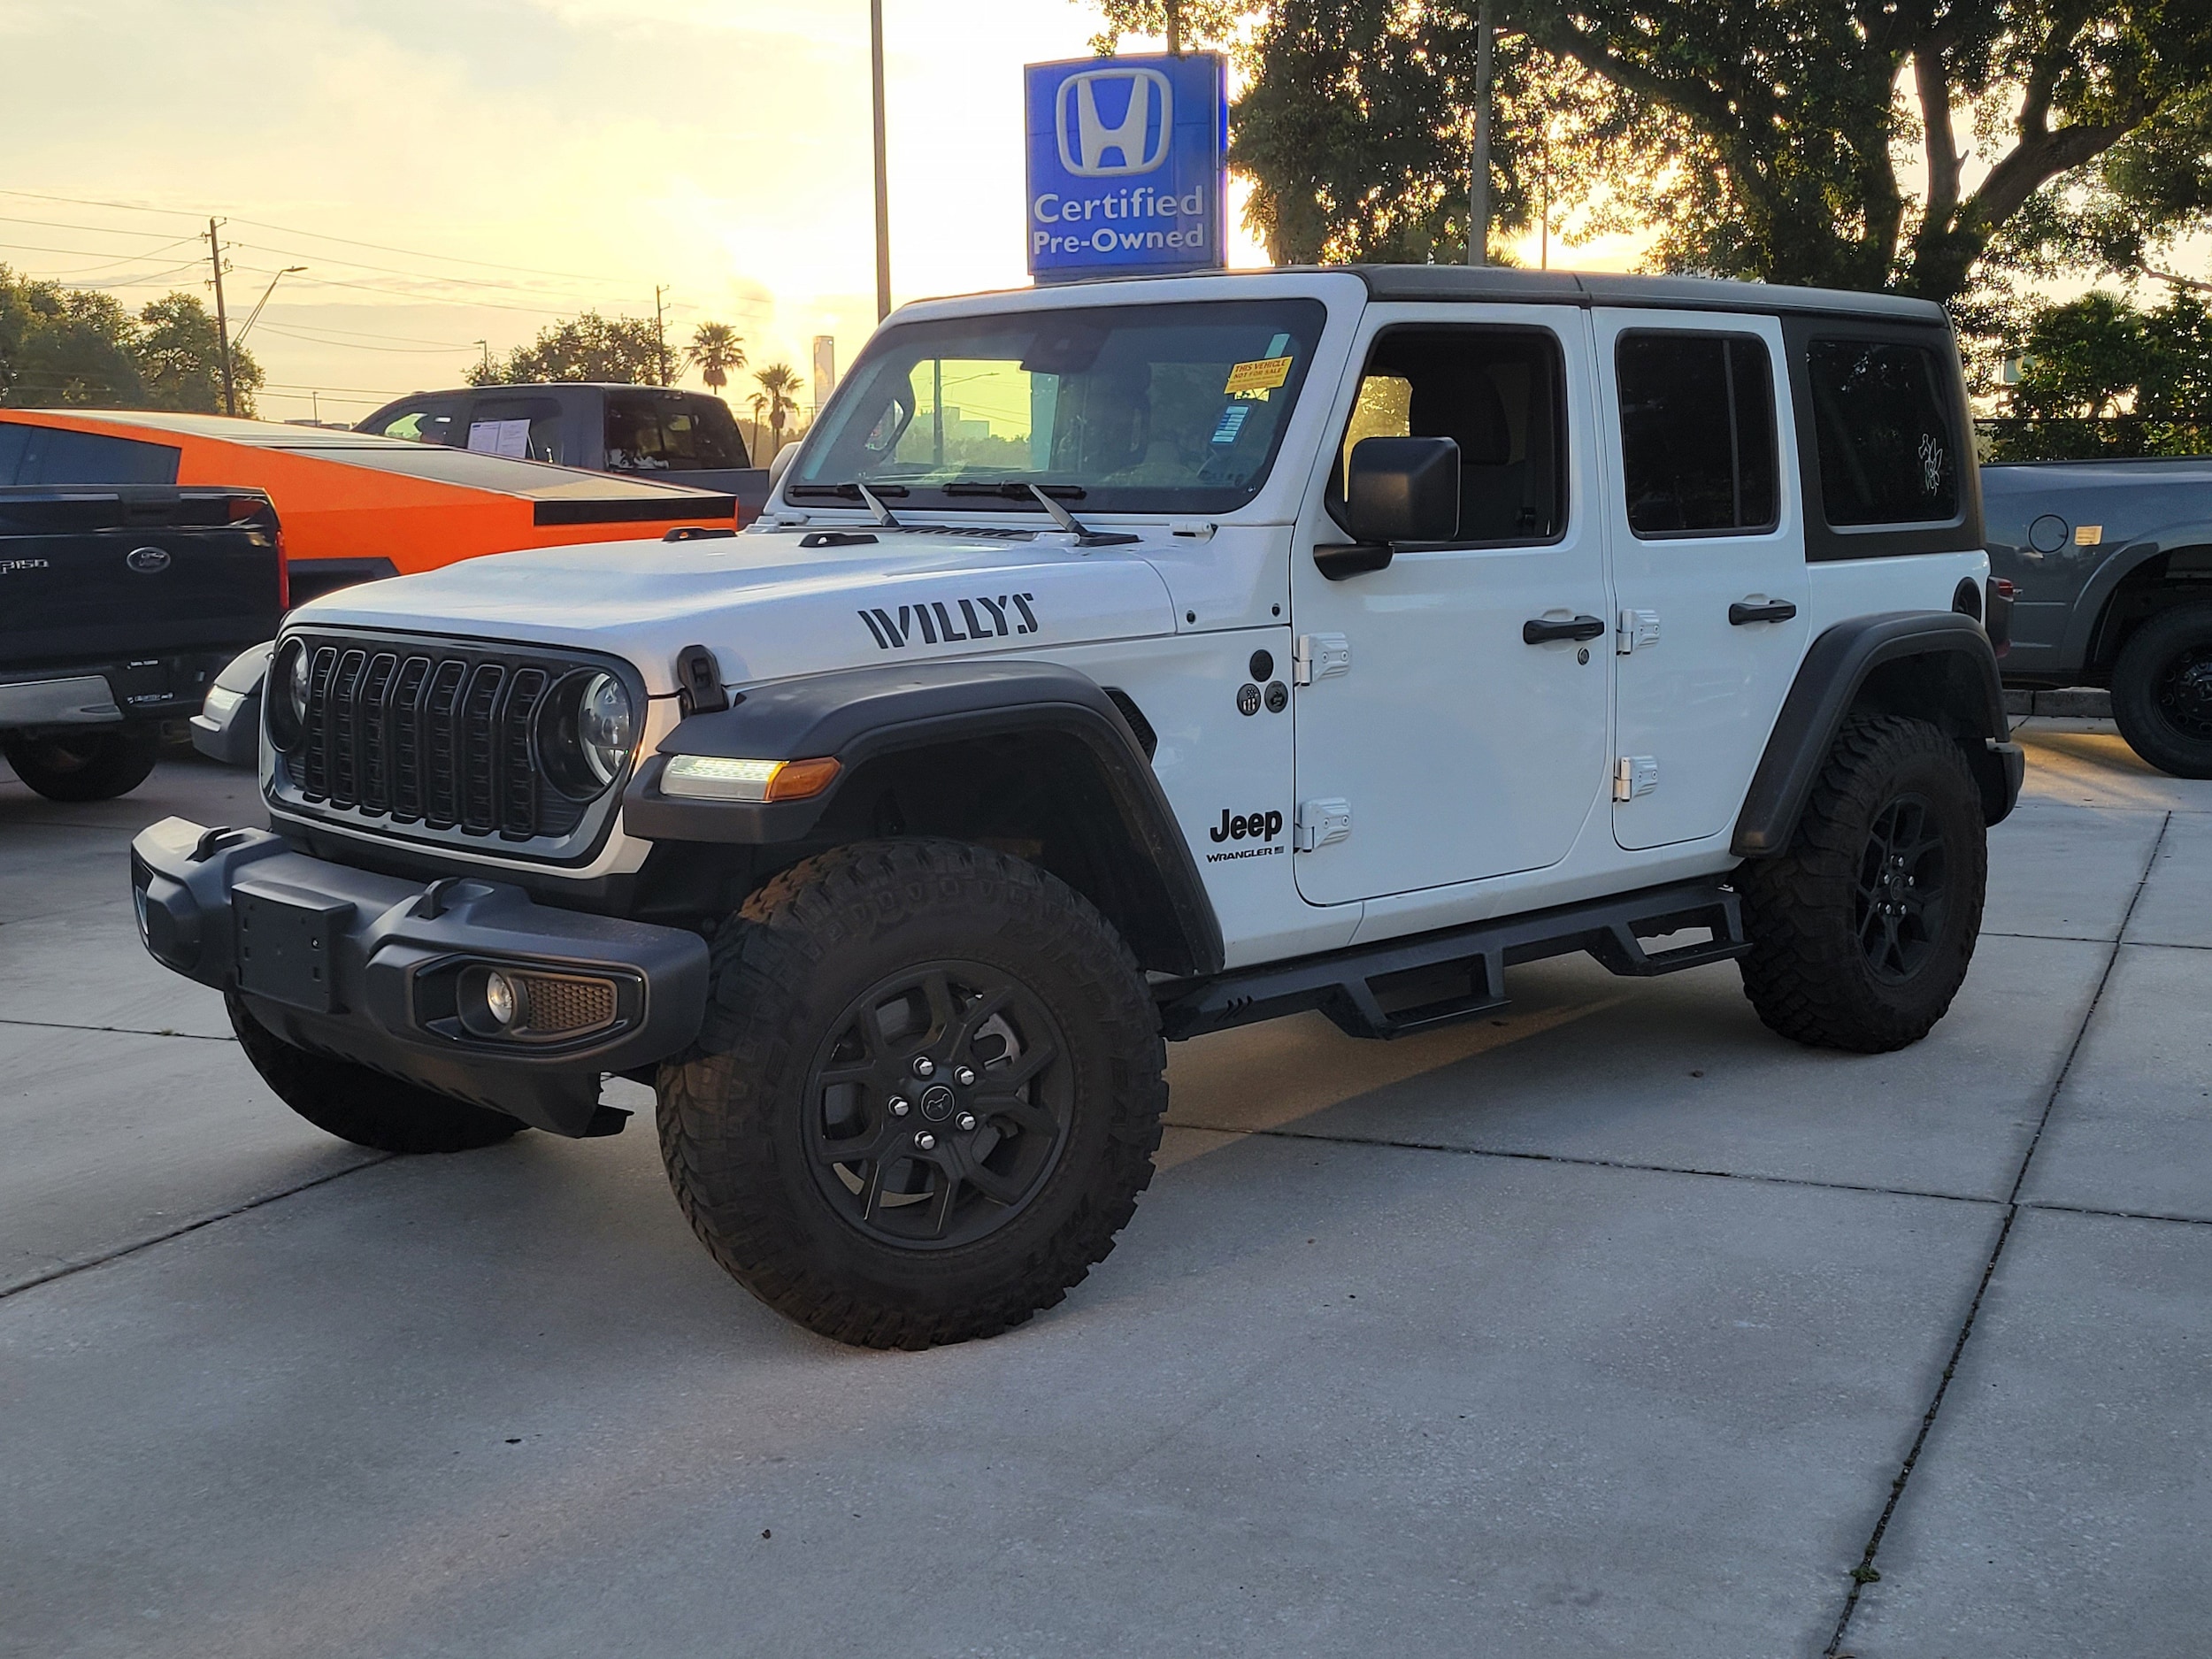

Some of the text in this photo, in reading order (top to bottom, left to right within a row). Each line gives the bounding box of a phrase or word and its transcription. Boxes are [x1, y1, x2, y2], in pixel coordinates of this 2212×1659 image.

[1033, 185, 1203, 224] Certified
[1033, 223, 1203, 255] Pre-Owned
[1235, 358, 1287, 373] THIS VEHICLE
[857, 593, 1039, 649] WILLYS
[1210, 809, 1283, 843] Jeep
[1207, 848, 1272, 863] WRANGLER
